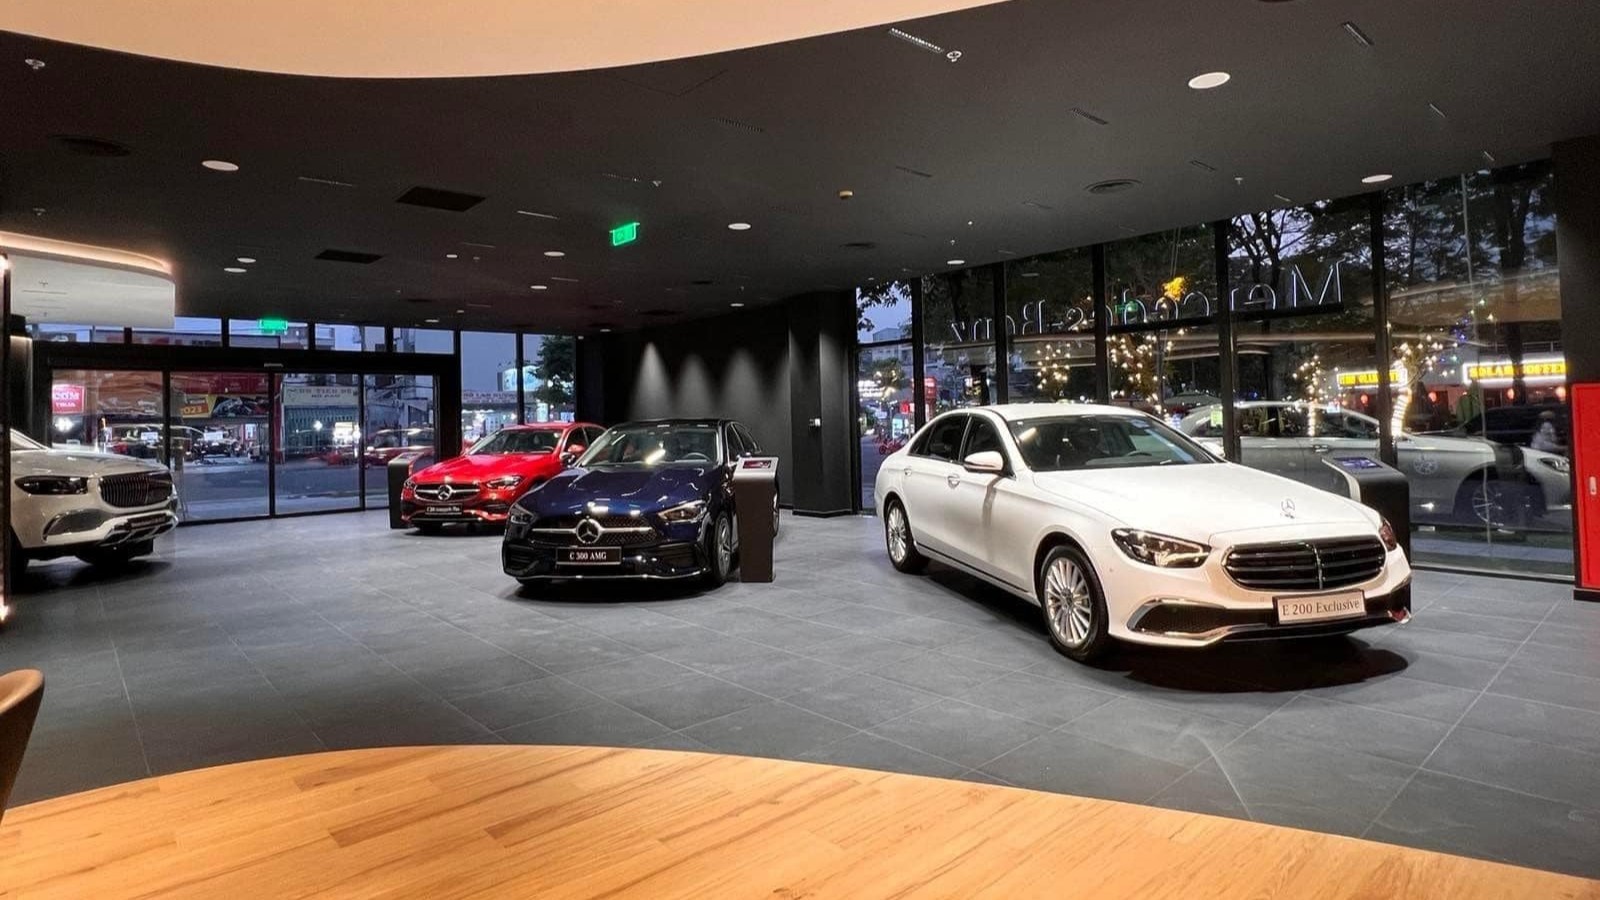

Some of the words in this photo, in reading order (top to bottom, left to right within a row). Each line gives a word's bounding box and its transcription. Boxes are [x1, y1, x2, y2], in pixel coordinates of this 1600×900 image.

[569, 551, 575, 560] C
[576, 551, 589, 560] 300
[590, 551, 607, 560] AMG
[1282, 604, 1290, 616] E
[1292, 603, 1313, 616] 200
[1316, 600, 1360, 614] Exclusive
